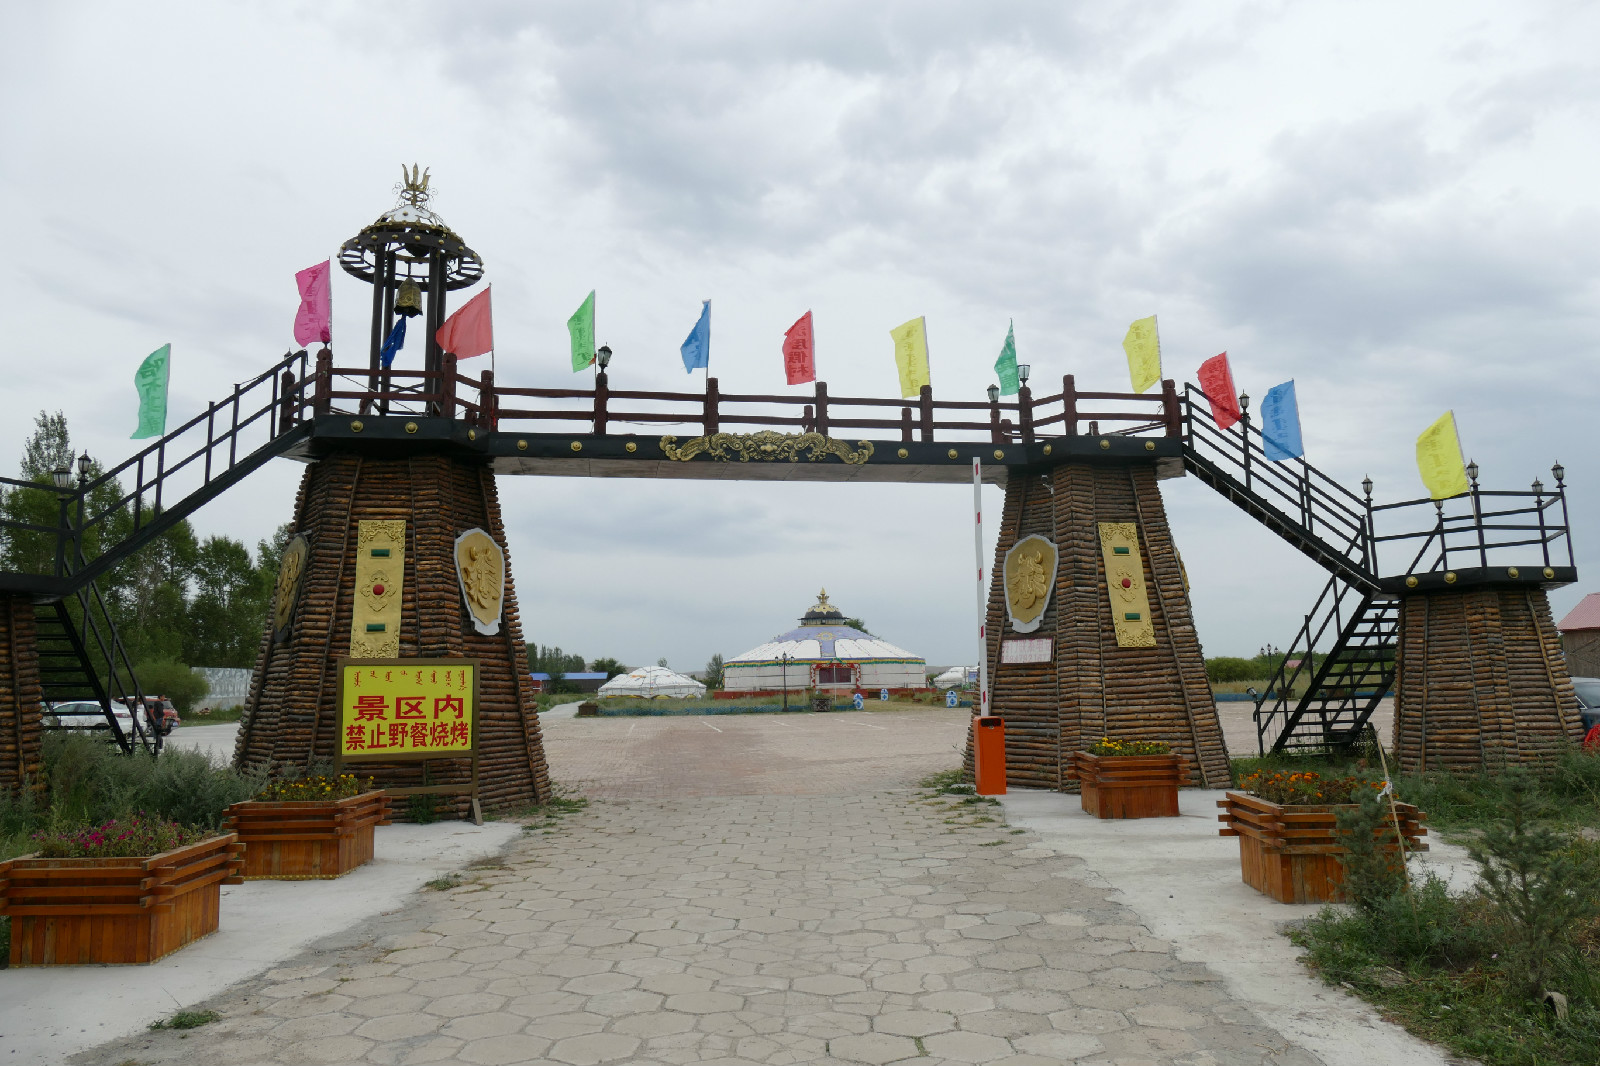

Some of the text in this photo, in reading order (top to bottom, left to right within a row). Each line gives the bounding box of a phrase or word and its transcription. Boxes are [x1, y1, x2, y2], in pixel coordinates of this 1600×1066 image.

[353, 694, 464, 722] 景区内
[346, 721, 469, 750] 禁止野餐烧烤
